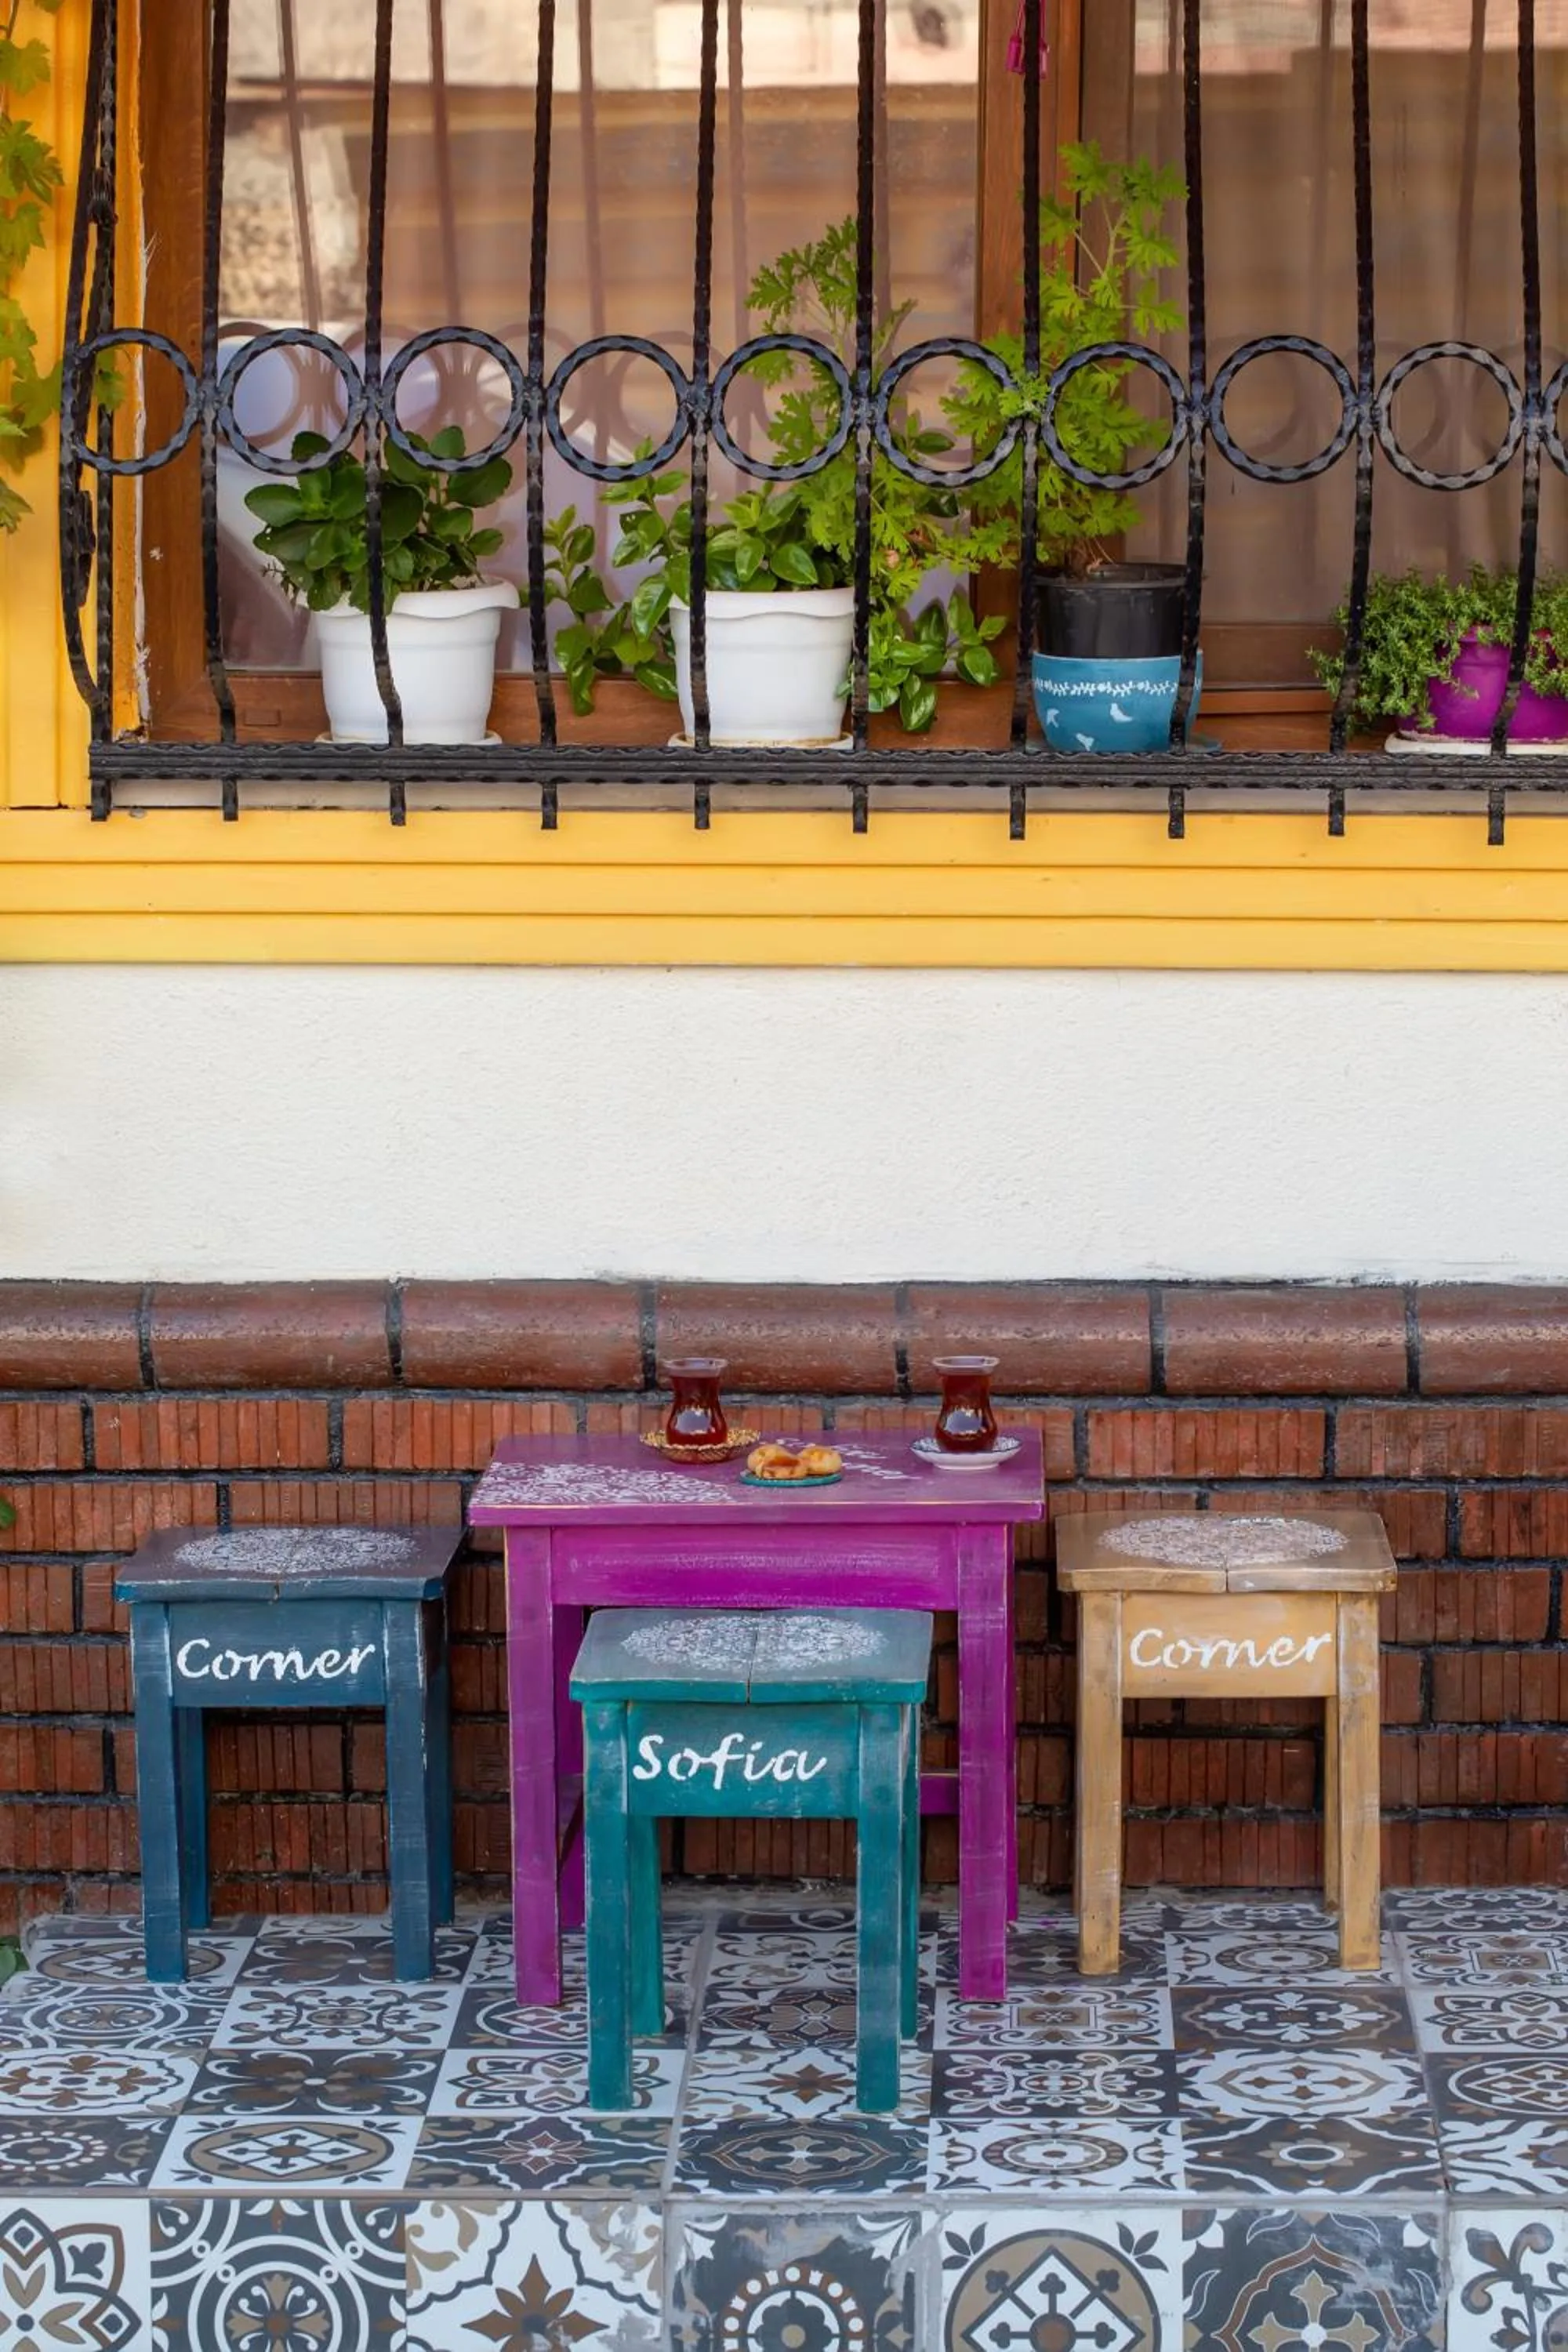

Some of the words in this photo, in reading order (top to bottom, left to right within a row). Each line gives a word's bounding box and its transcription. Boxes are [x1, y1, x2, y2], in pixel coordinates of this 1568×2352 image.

[176, 1638, 376, 1681] Corner
[1129, 1628, 1331, 1669] Corner
[633, 1733, 827, 1790] Sofia
